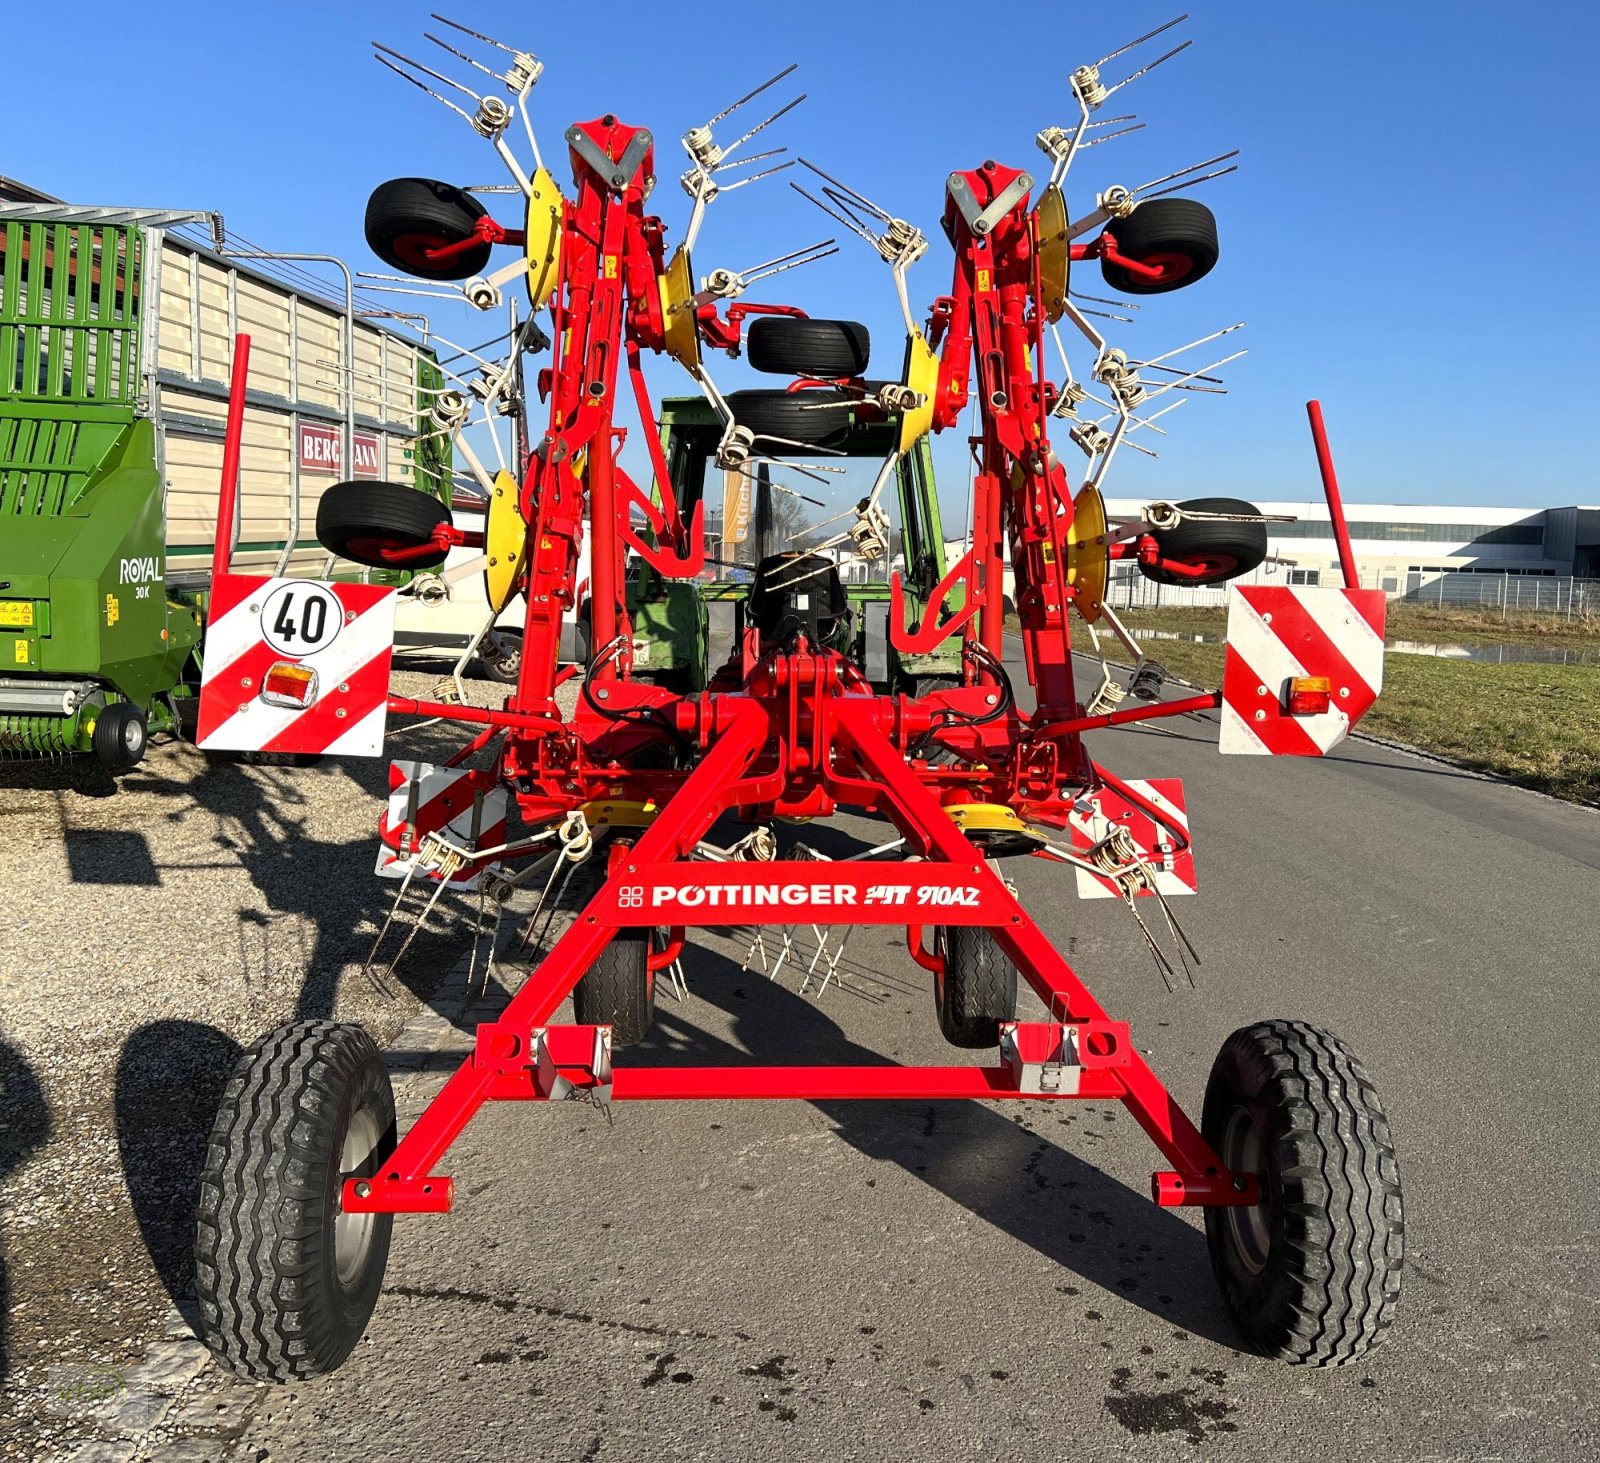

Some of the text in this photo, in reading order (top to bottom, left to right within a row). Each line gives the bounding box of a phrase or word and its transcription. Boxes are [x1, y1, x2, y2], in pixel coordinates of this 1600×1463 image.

[303, 435, 377, 468] BERGANN
[120, 557, 163, 584] ROYAL
[273, 592, 327, 644] 40
[652, 884, 857, 907] PÖTTINGER
[917, 886, 980, 906] 910AZ
